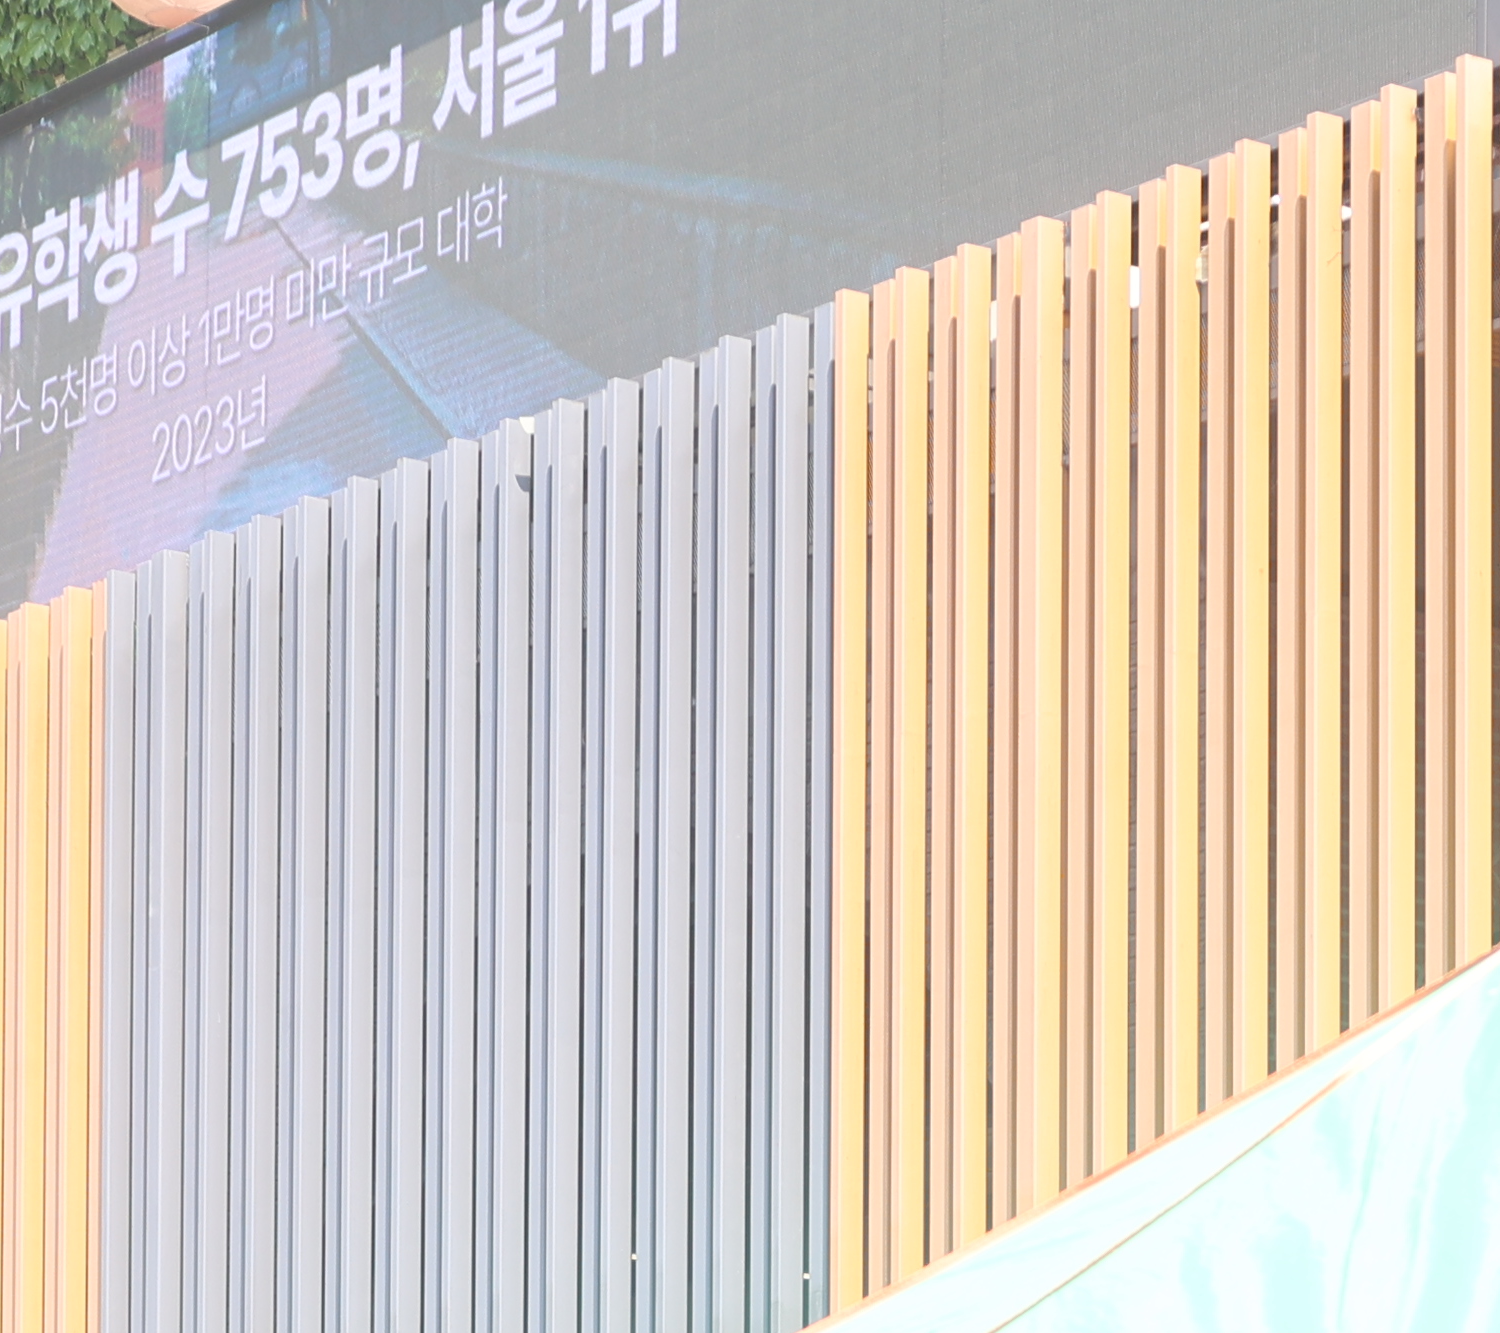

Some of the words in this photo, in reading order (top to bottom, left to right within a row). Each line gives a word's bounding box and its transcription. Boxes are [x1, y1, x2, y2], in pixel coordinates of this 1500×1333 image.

[152, 150, 213, 278] 수
[221, 44, 420, 243] 753명,
[433, 0, 564, 138] 서울
[41, 343, 118, 435] 5천명
[127, 314, 190, 396] 이상
[199, 275, 275, 368] 1만명
[286, 244, 352, 328] 미만
[359, 217, 427, 303] 규모
[437, 176, 508, 262] 대학
[151, 374, 269, 484] 2023년
